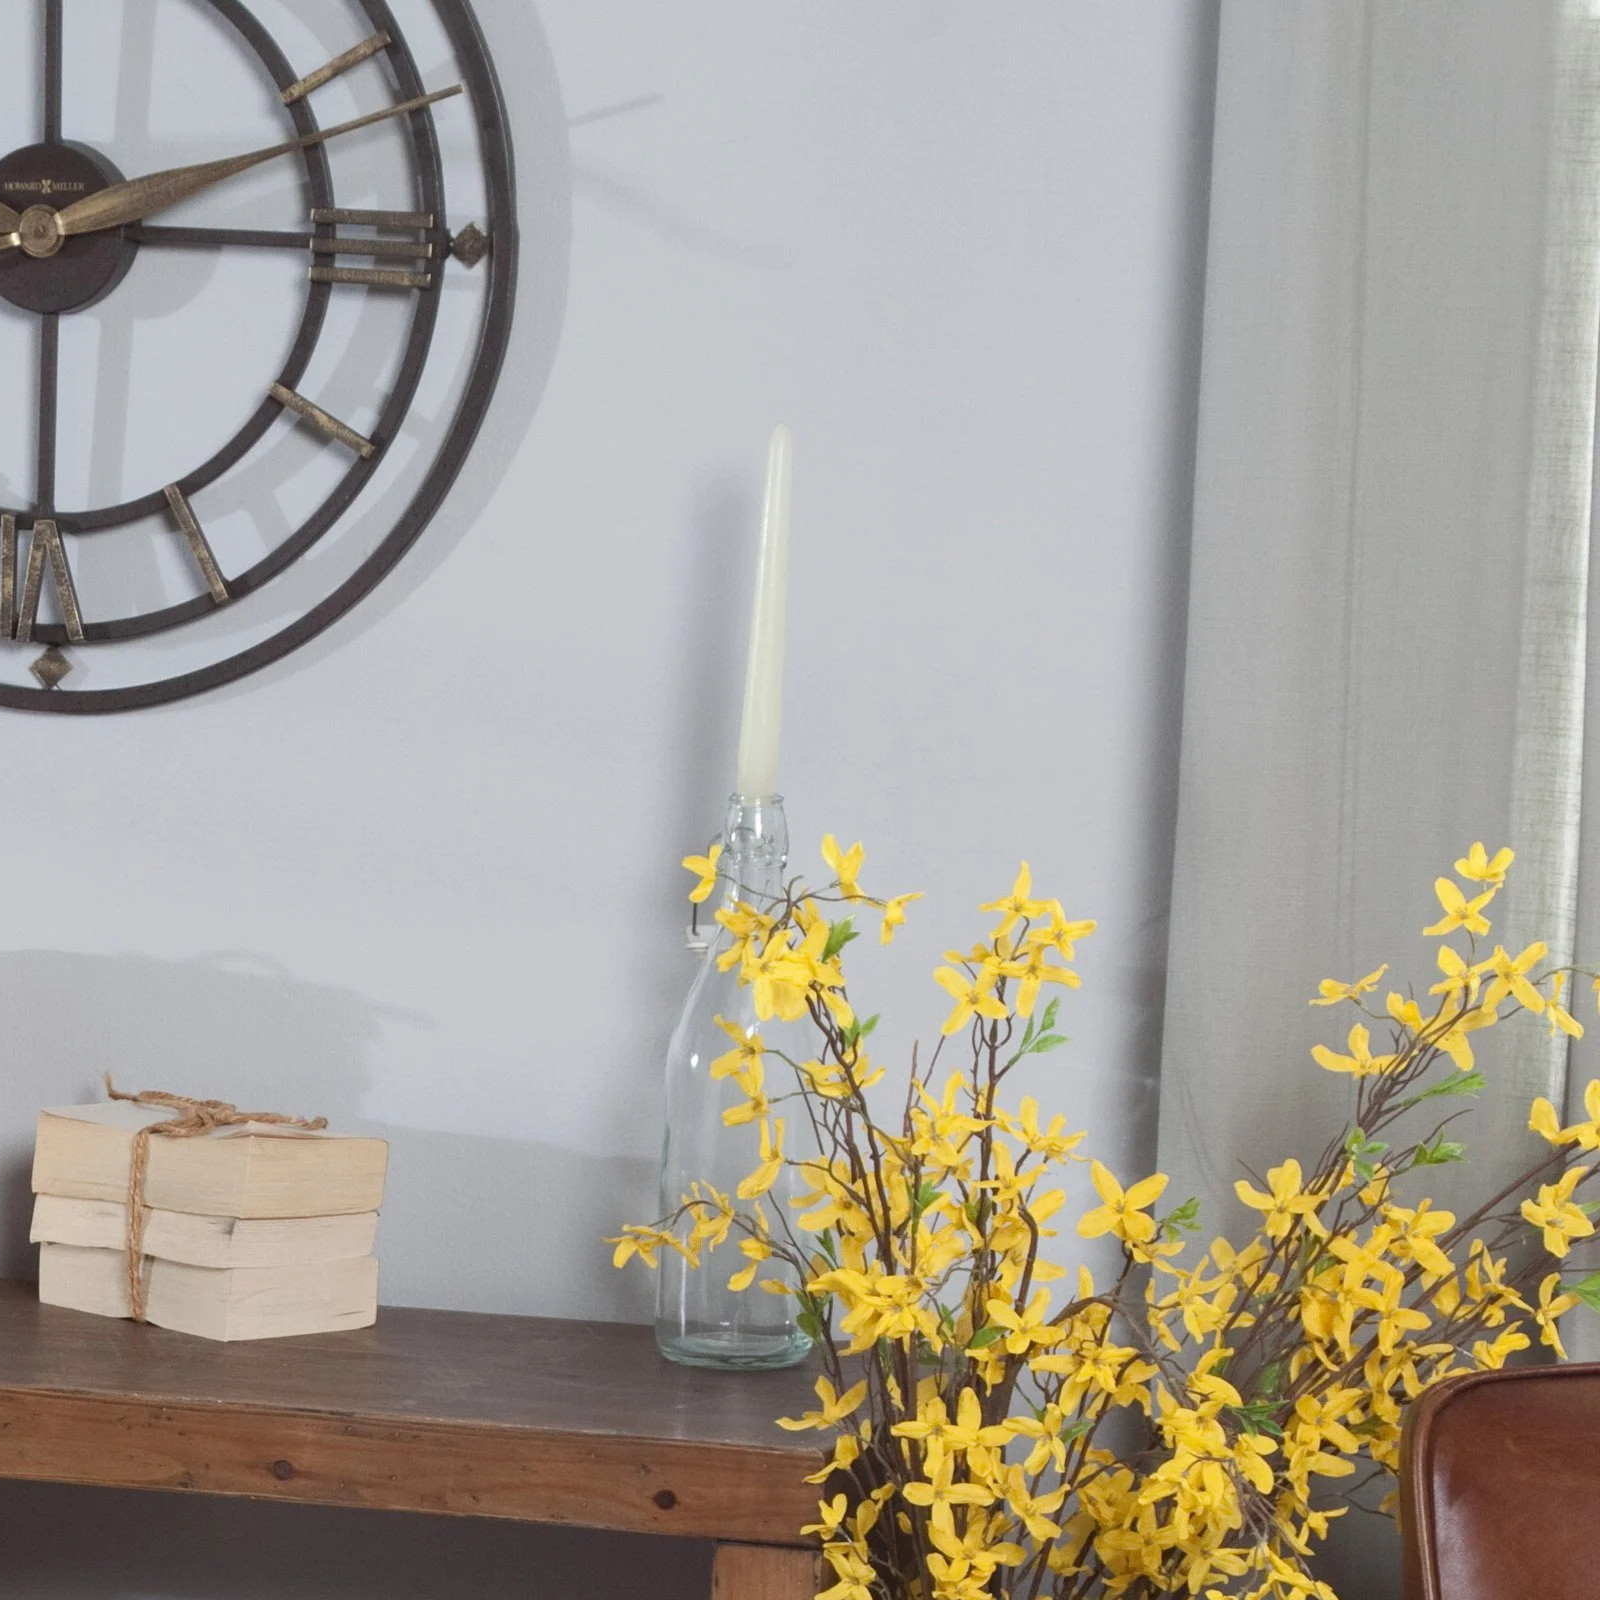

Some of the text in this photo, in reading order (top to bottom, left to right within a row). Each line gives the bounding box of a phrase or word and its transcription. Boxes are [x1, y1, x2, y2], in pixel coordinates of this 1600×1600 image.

[4, 182, 85, 191] HOWARD MILLER
[309, 207, 436, 288] III
